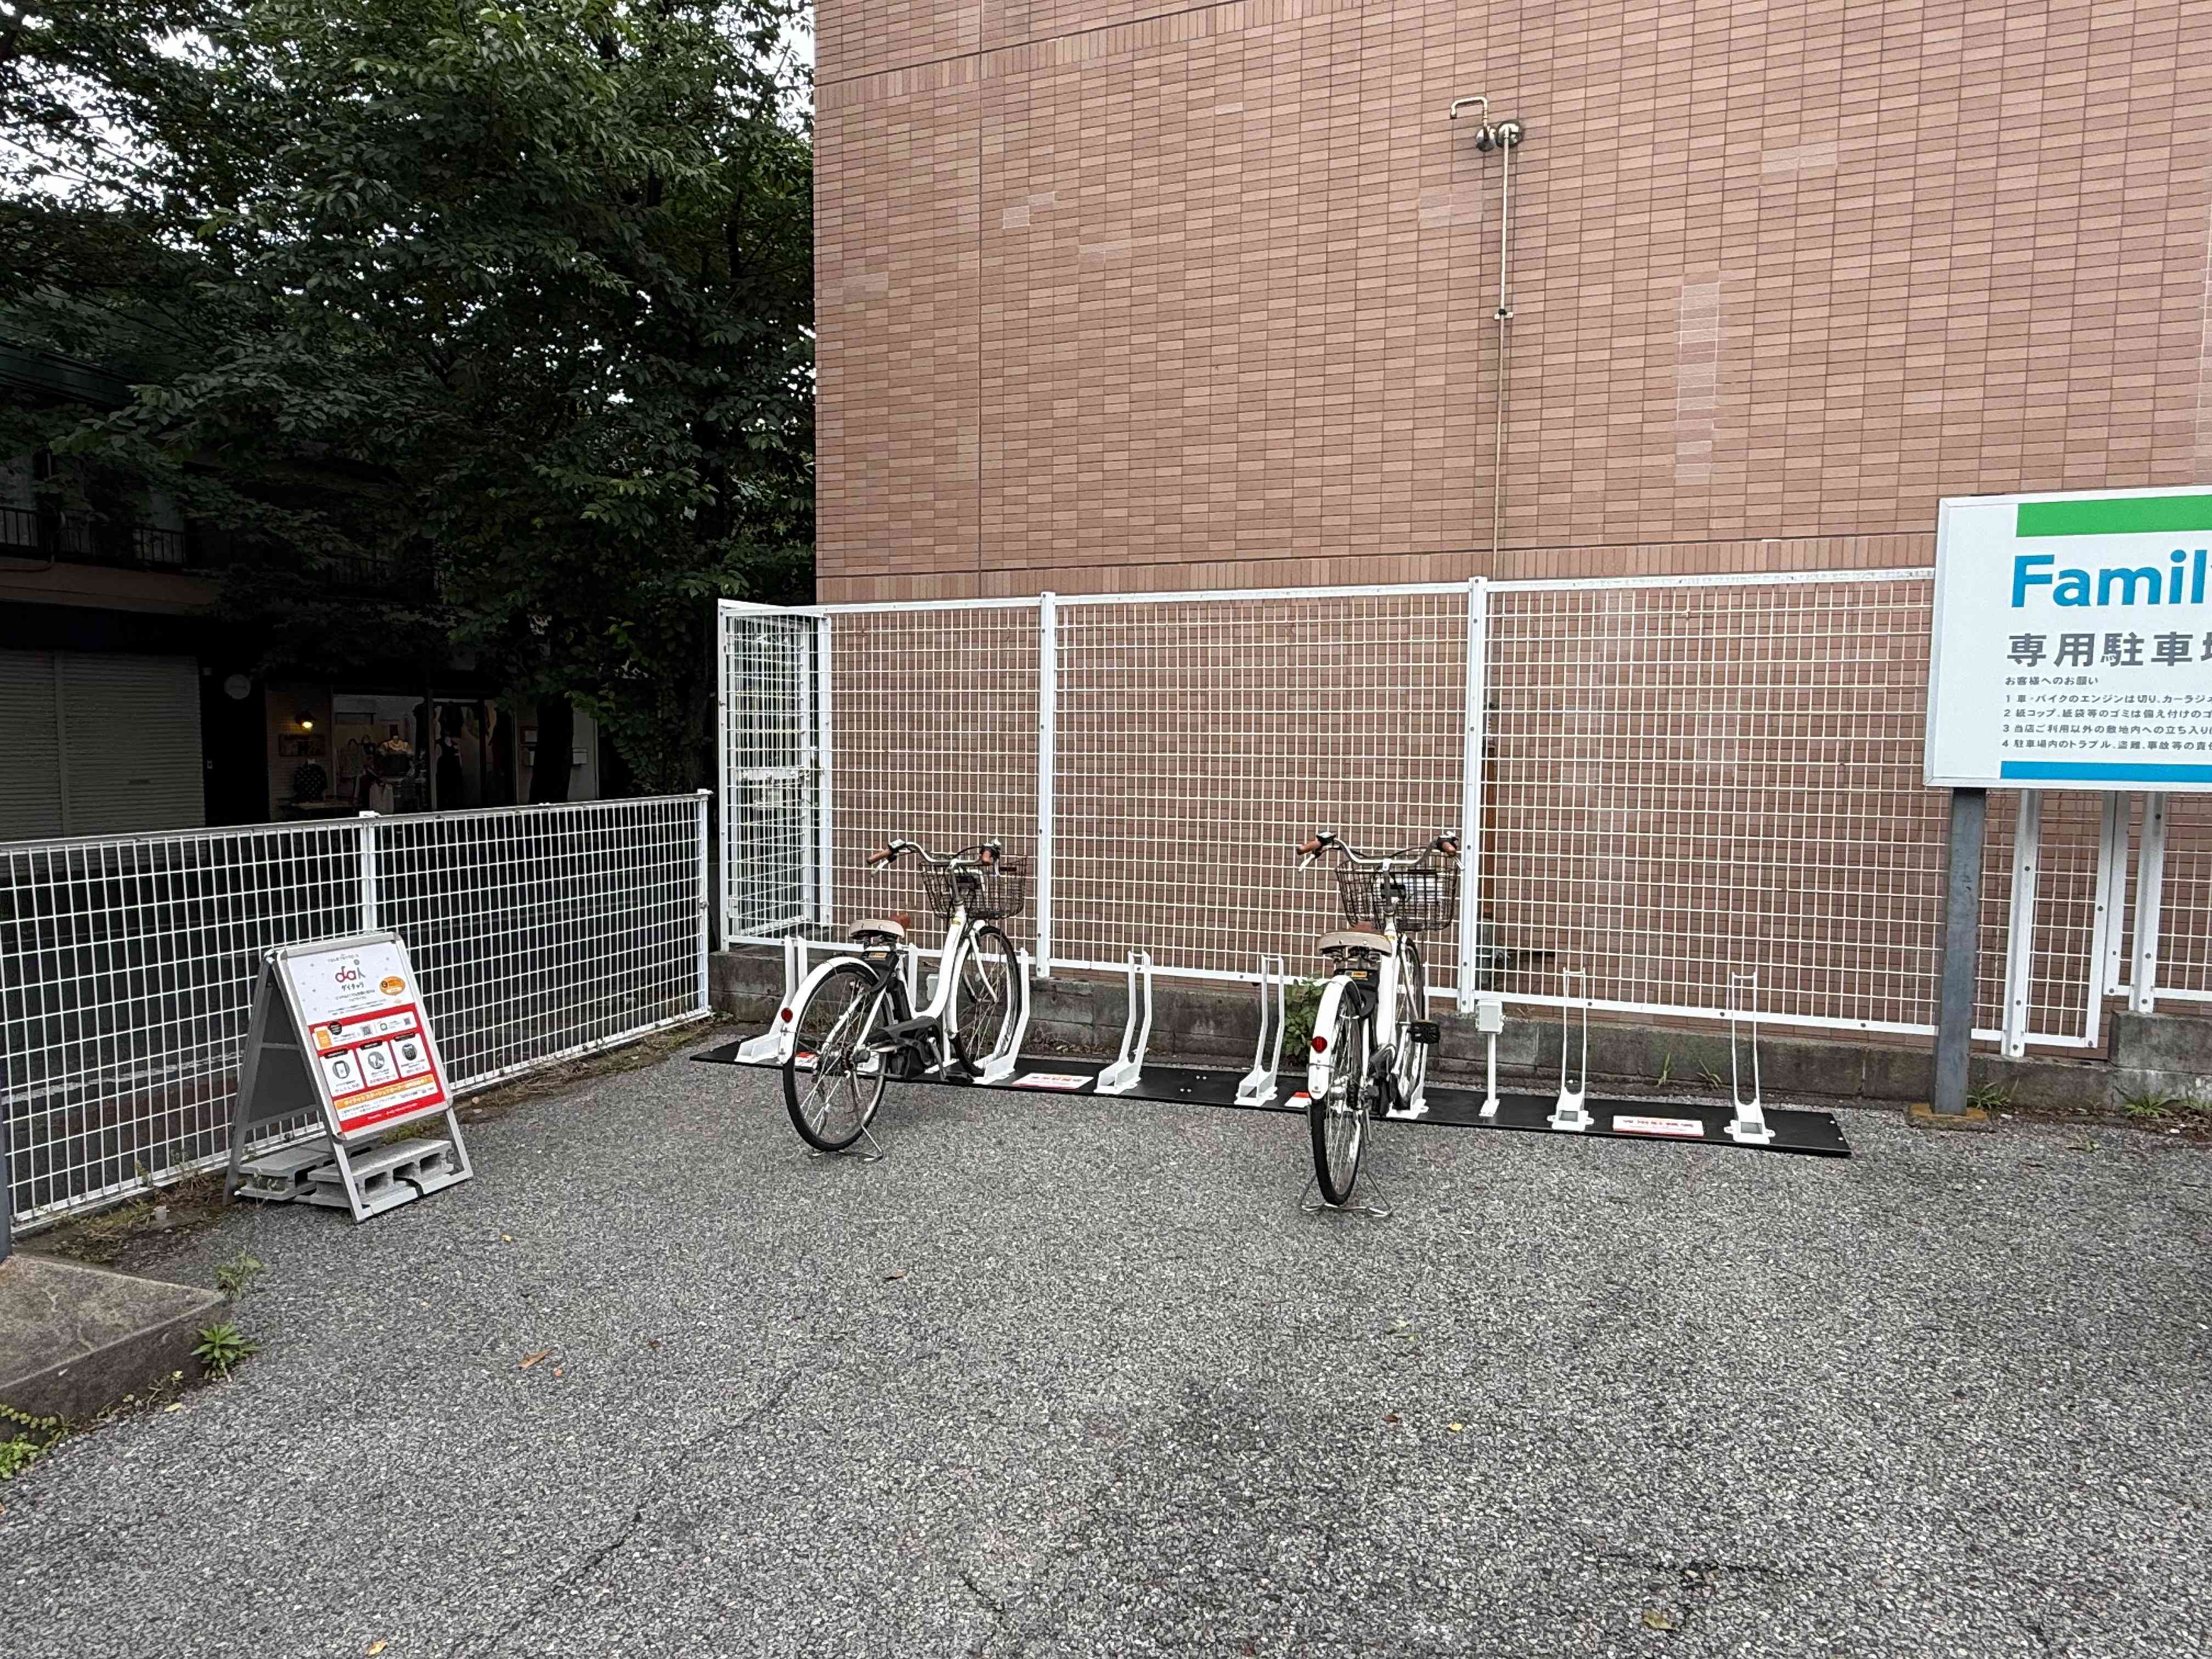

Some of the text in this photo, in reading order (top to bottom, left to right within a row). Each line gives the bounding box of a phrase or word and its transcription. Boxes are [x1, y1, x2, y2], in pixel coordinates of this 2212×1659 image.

[2011, 549, 2212, 608] Famil
[2005, 676, 2099, 686] お客様へのお願い
[2014, 724, 2212, 735] 当店ご利用以外の敷地内への立ち入り
